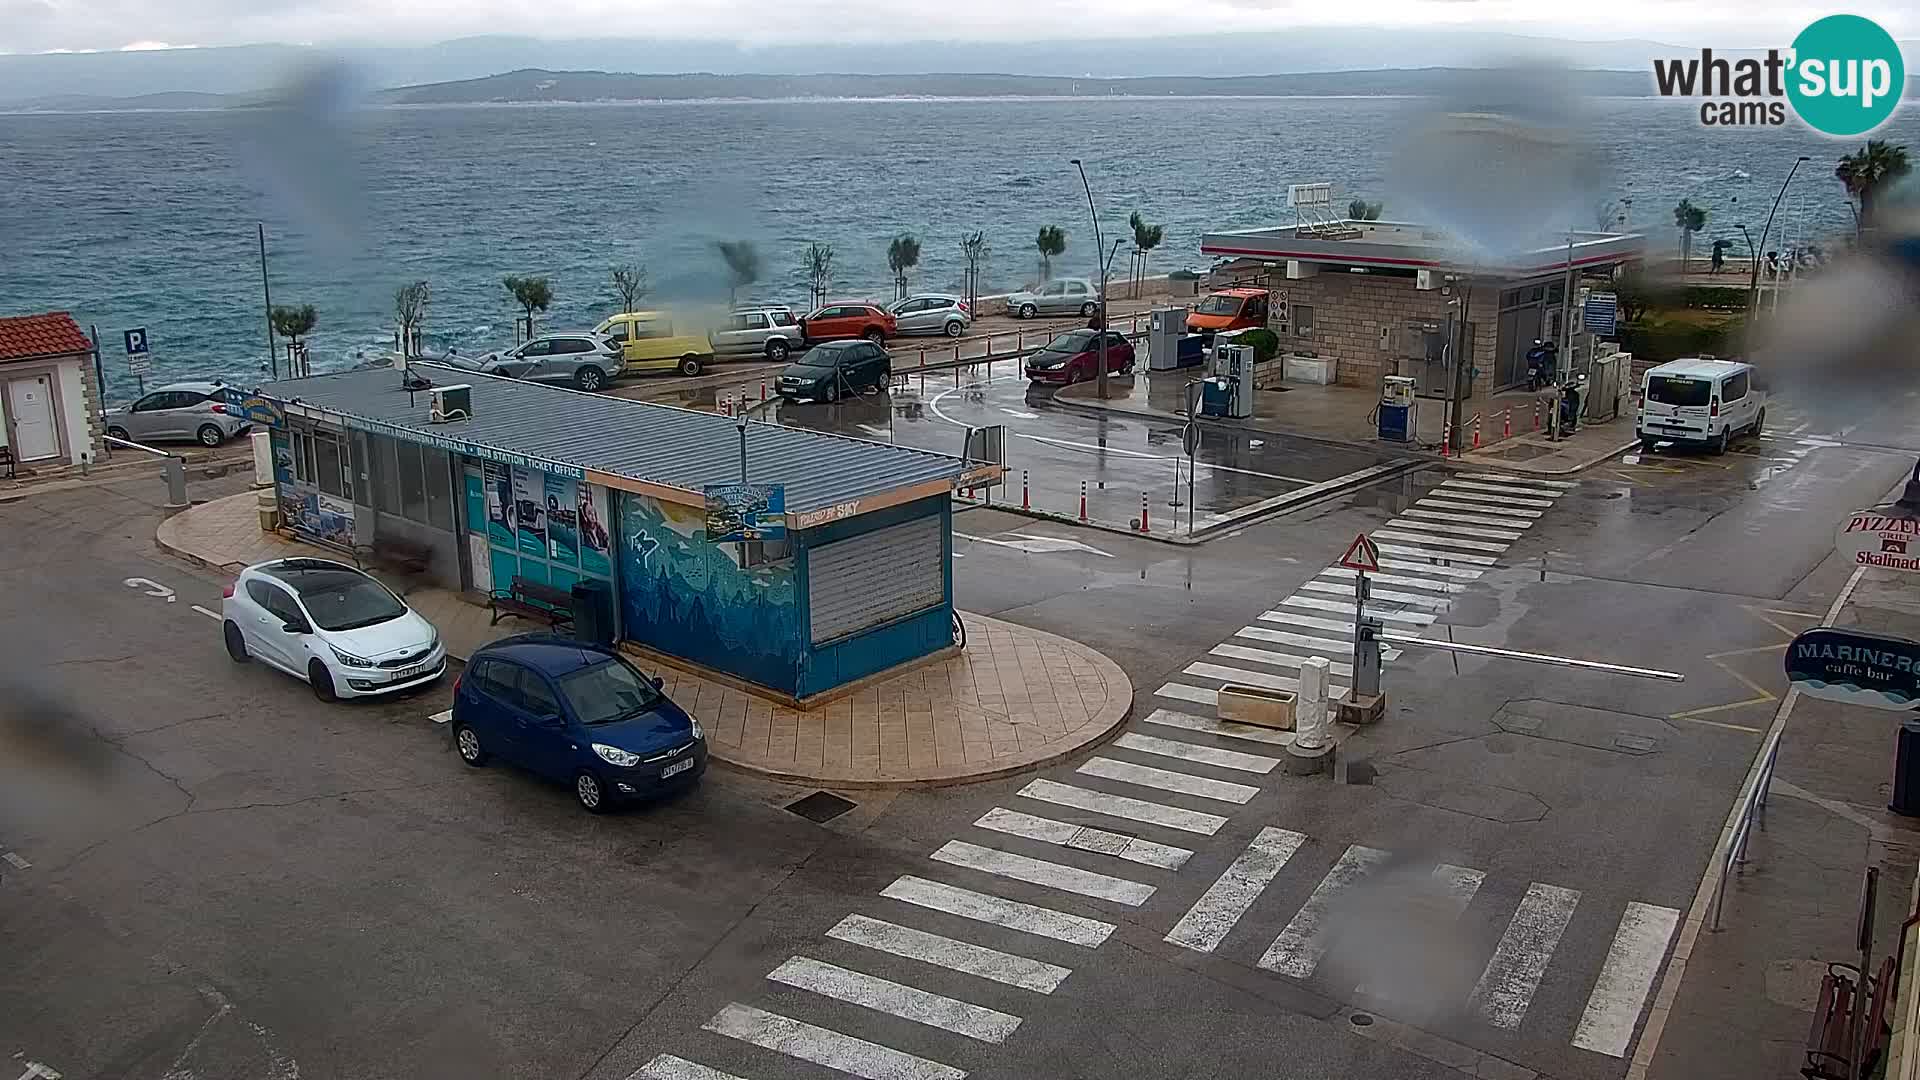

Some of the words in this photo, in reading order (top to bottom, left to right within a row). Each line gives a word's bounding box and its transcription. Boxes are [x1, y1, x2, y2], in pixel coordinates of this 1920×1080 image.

[130, 332, 142, 351] P
[477, 446, 492, 459] BUS
[493, 450, 525, 466] STATION
[527, 458, 553, 473] TICKET
[554, 464, 581, 478] OFFICE
[1867, 666, 1894, 681] bar
